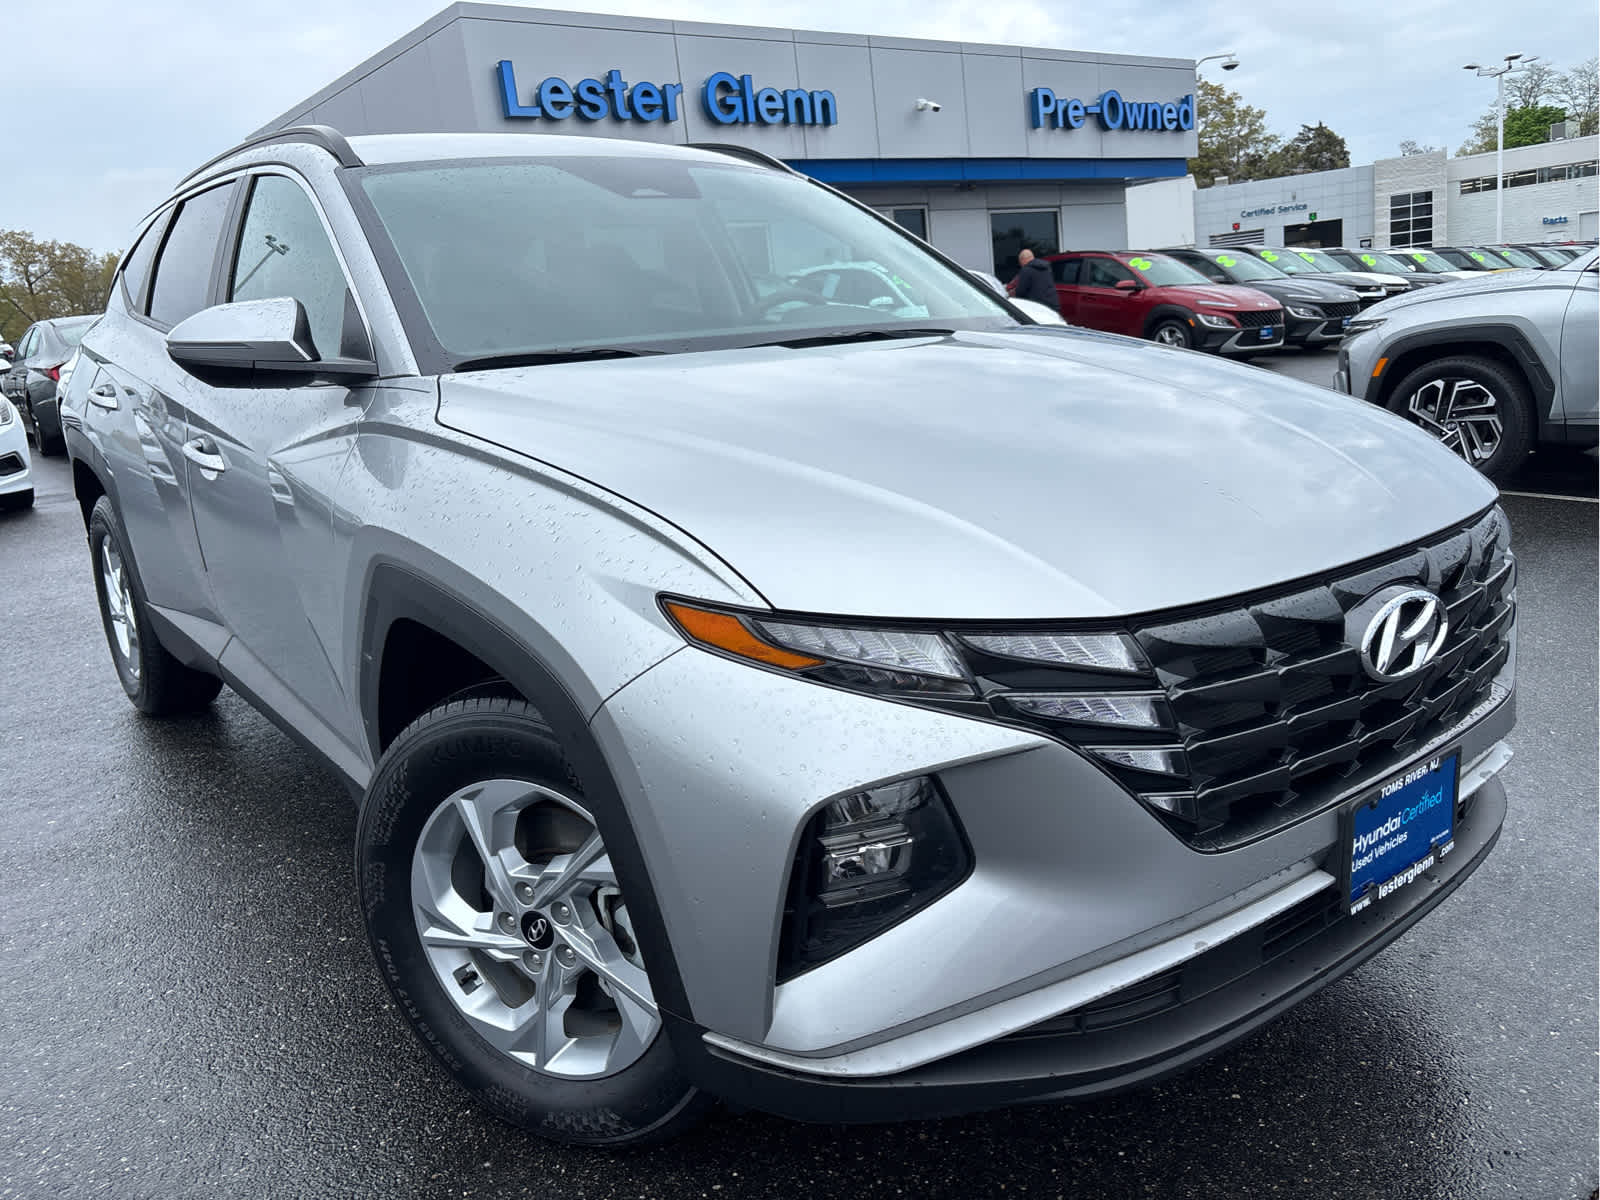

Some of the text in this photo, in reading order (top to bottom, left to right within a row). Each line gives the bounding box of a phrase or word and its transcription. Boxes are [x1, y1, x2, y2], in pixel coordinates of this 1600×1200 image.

[496, 60, 837, 126] Lester Glenn
[1031, 88, 1193, 131] Pre-Owned
[1240, 203, 1307, 218] Certified Service
[1542, 216, 1568, 225] Parts
[1380, 778, 1404, 799] TOMS
[1430, 758, 1440, 770] NJ
[1352, 812, 1401, 855] Hyundai
[1402, 785, 1443, 825] Certified
[1351, 853, 1374, 873] Used
[1373, 831, 1408, 858] Vehicles
[1378, 855, 1434, 899] lesterglenn
